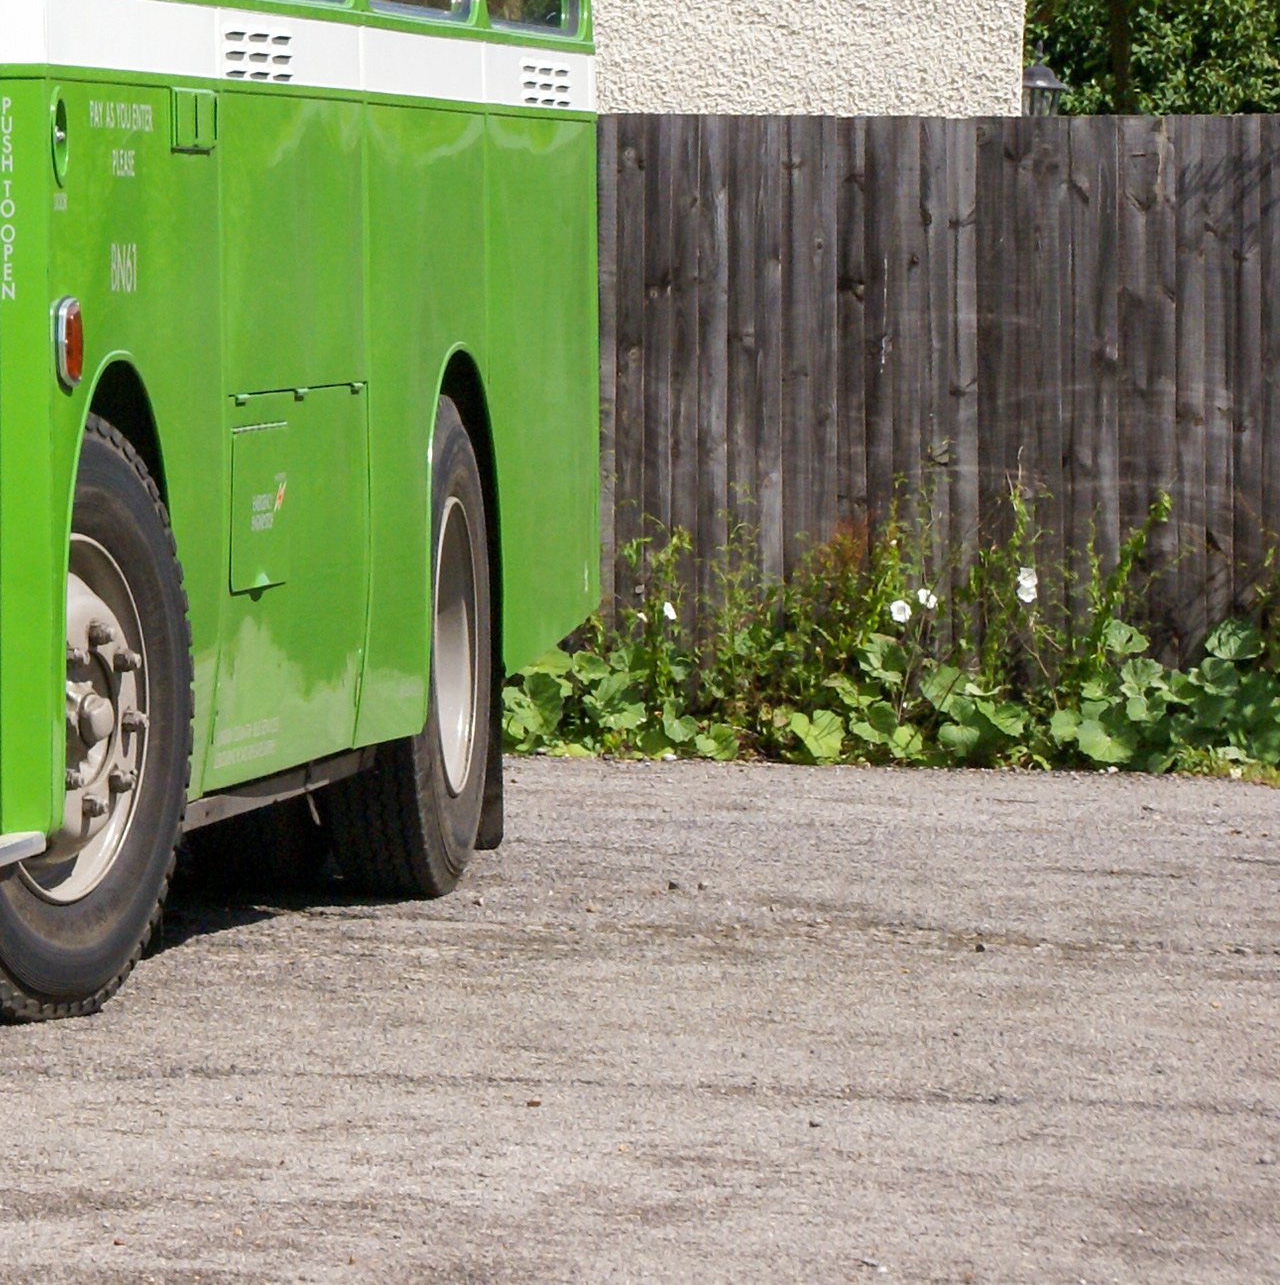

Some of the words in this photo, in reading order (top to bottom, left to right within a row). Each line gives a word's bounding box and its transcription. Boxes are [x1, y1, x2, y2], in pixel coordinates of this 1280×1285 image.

[0, 97, 13, 173] PUSH
[89, 100, 103, 128] PAY
[105, 101, 115, 129] AS
[116, 102, 131, 130] YOU
[0, 180, 15, 219] TO
[0, 224, 16, 301] OPEN
[110, 243, 137, 293] BN61
